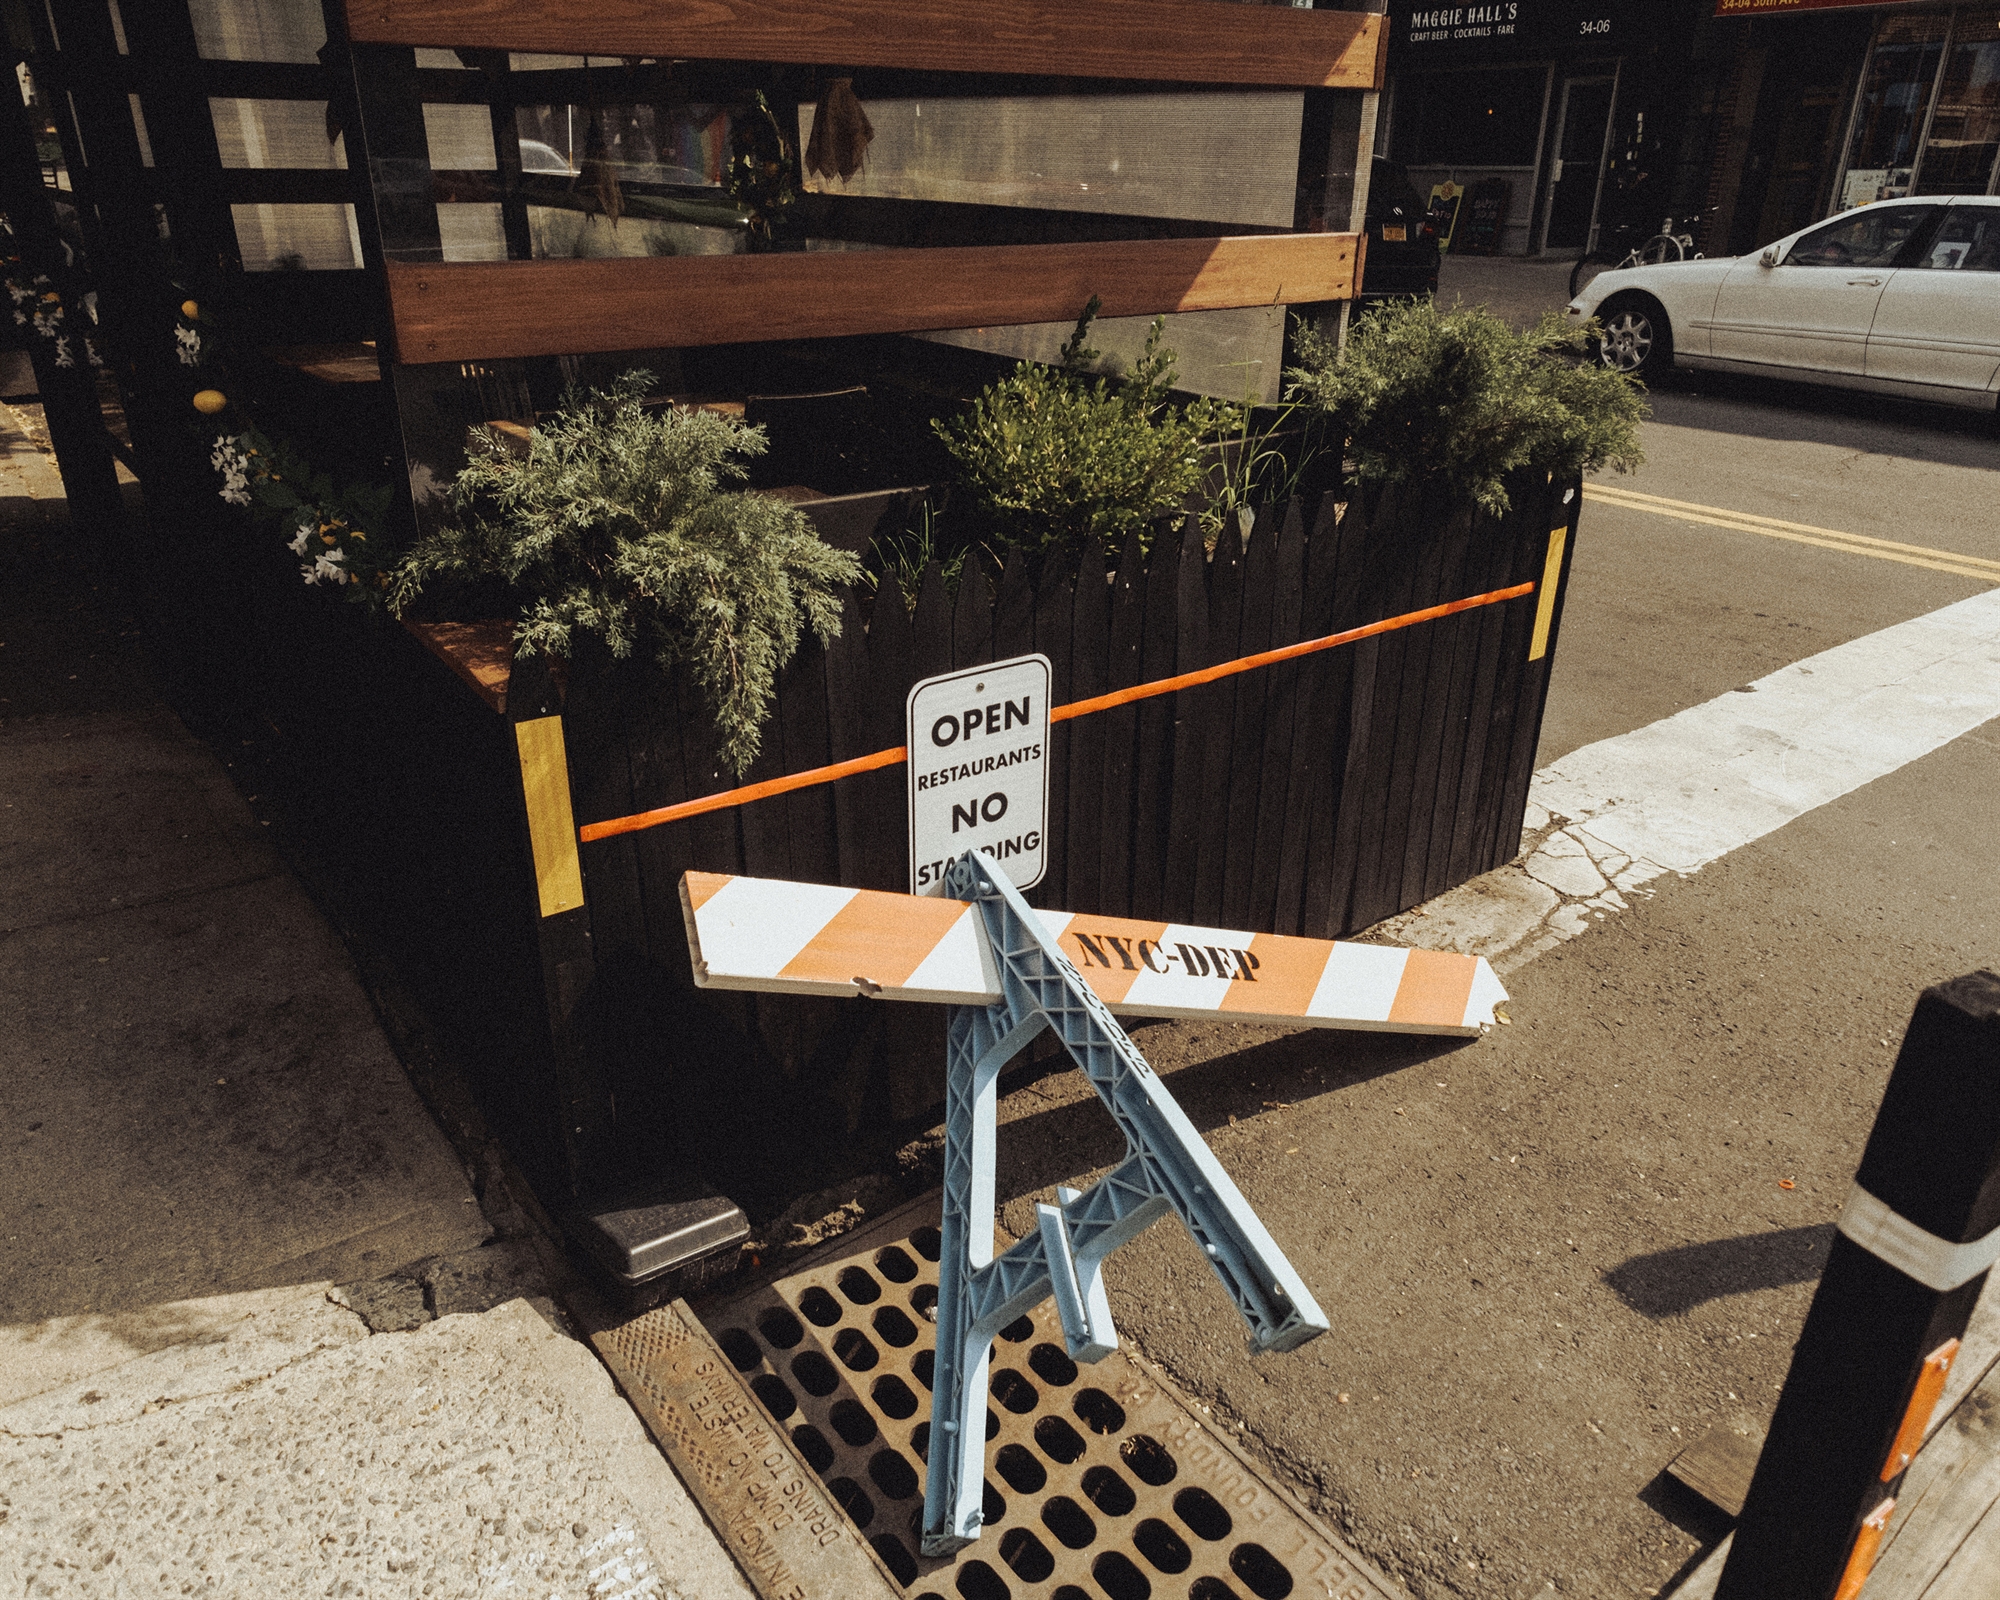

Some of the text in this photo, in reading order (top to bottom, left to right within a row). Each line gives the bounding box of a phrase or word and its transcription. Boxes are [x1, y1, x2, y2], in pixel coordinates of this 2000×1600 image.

[1410, 24, 1515, 42] CRAFT BEER COCKTAILS FARE
[1411, 2, 1518, 29] MAGGIE HALL'S
[1579, 19, 1611, 35] 34-06
[931, 696, 1030, 747] OPEN
[918, 744, 1042, 791] RESTAURANTS
[952, 791, 1009, 834] NO
[917, 831, 1041, 886] STADING
[1072, 932, 1261, 982] NYC-DEP
[696, 1361, 773, 1453] WATERWAYS
[728, 1452, 758, 1480] NO
[763, 1452, 791, 1480] TO
[1155, 1418, 1274, 1524] FOUNDRY
[747, 1483, 793, 1531] DUMP
[783, 1479, 840, 1547] DRAINS
[730, 1508, 777, 1563] INDIA
